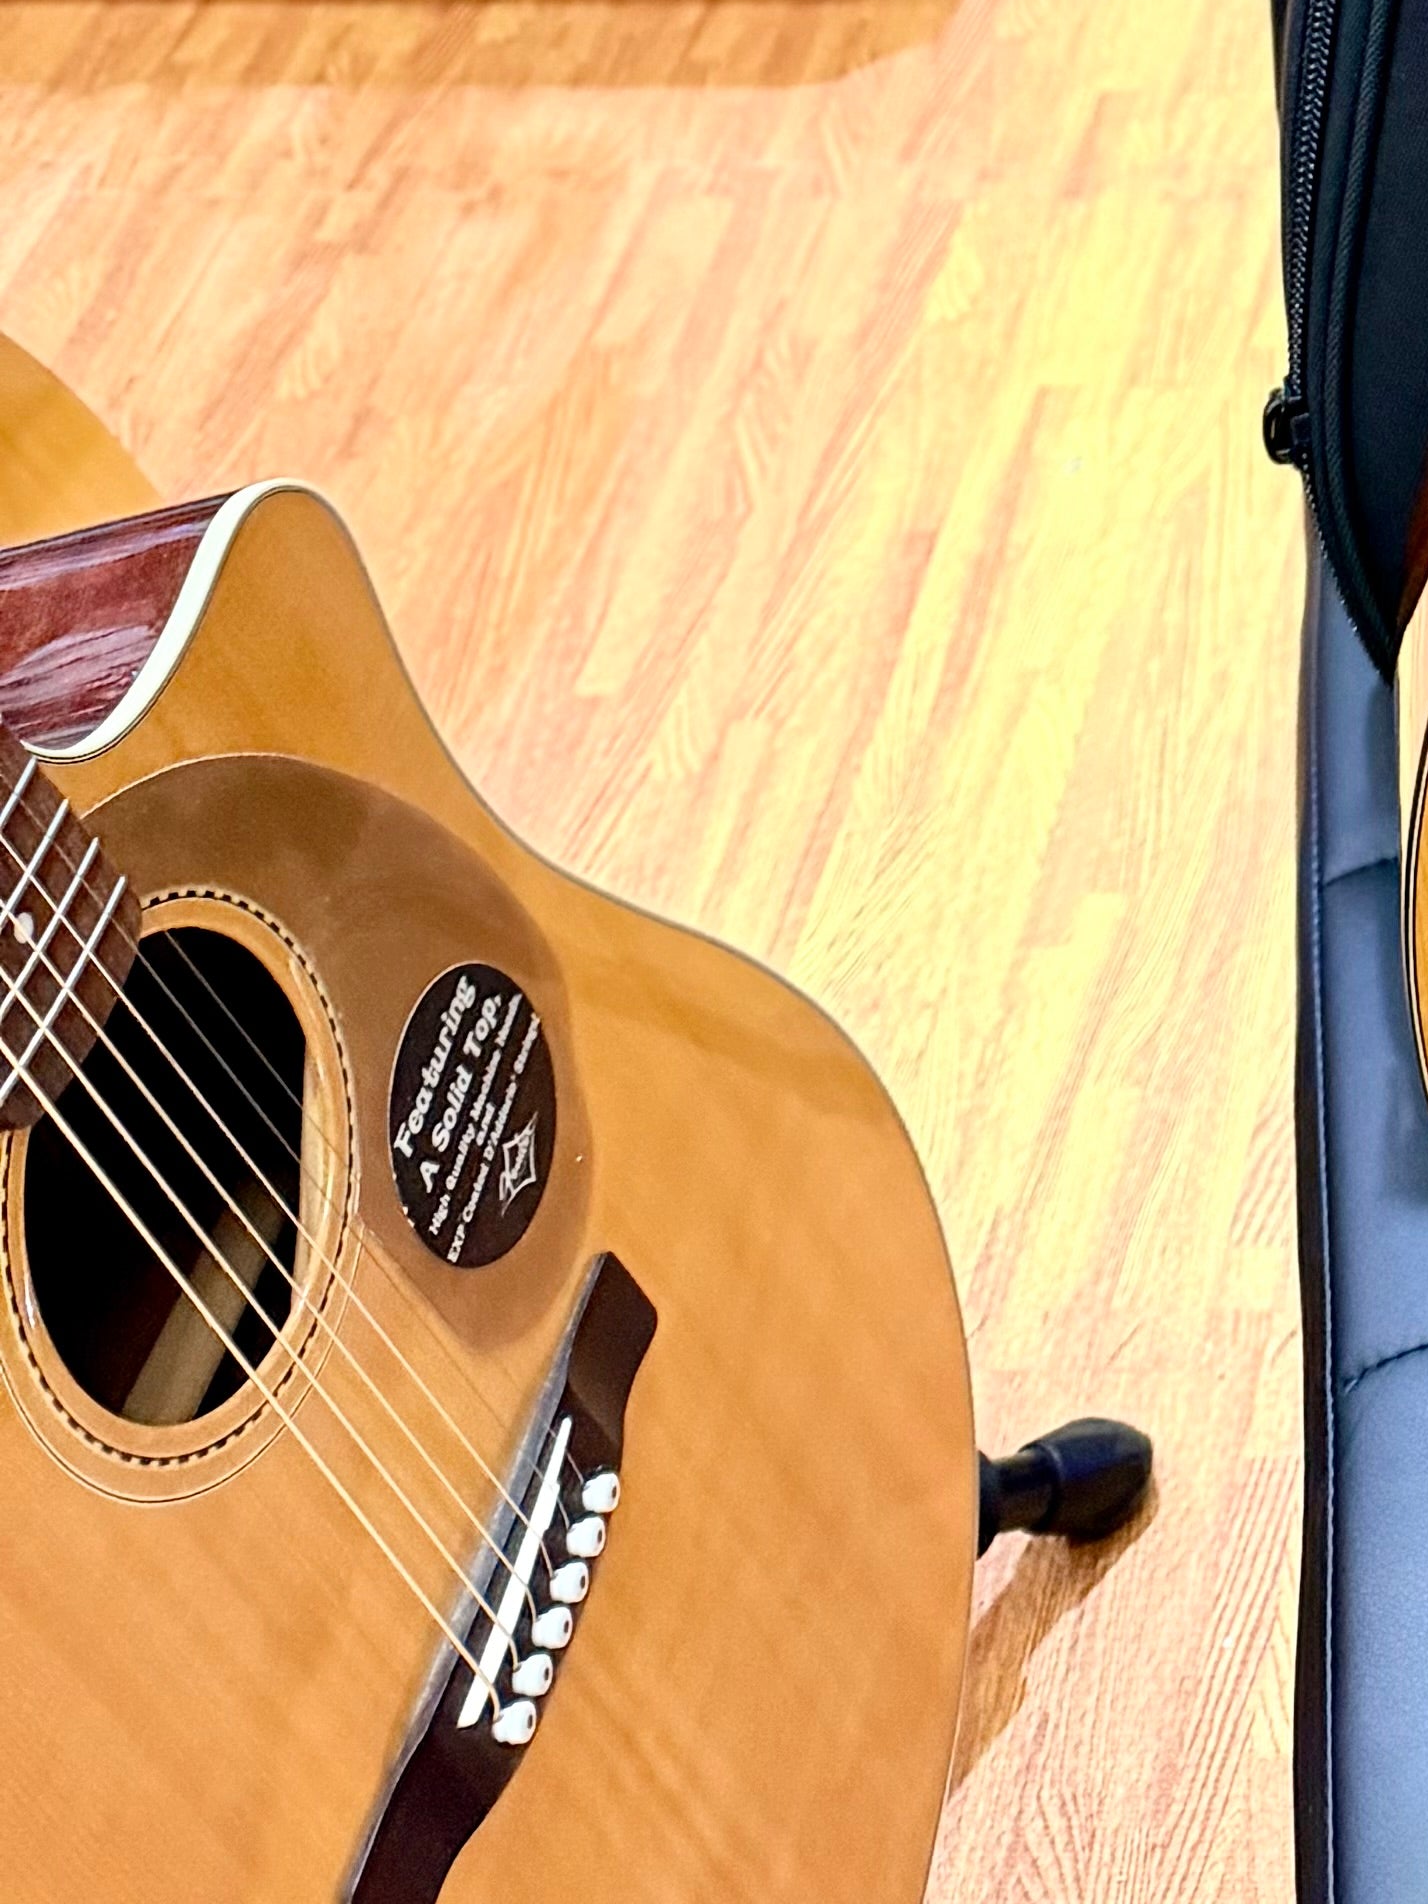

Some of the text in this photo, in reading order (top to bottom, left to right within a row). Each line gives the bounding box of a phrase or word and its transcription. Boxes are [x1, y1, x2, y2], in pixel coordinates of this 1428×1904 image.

[393, 974, 477, 1159] Featuring
[476, 1101, 496, 1147] and
[420, 1160, 441, 1194] A
[431, 1064, 473, 1152] Solid
[428, 1194, 451, 1236] High
[446, 1122, 476, 1191] Quality
